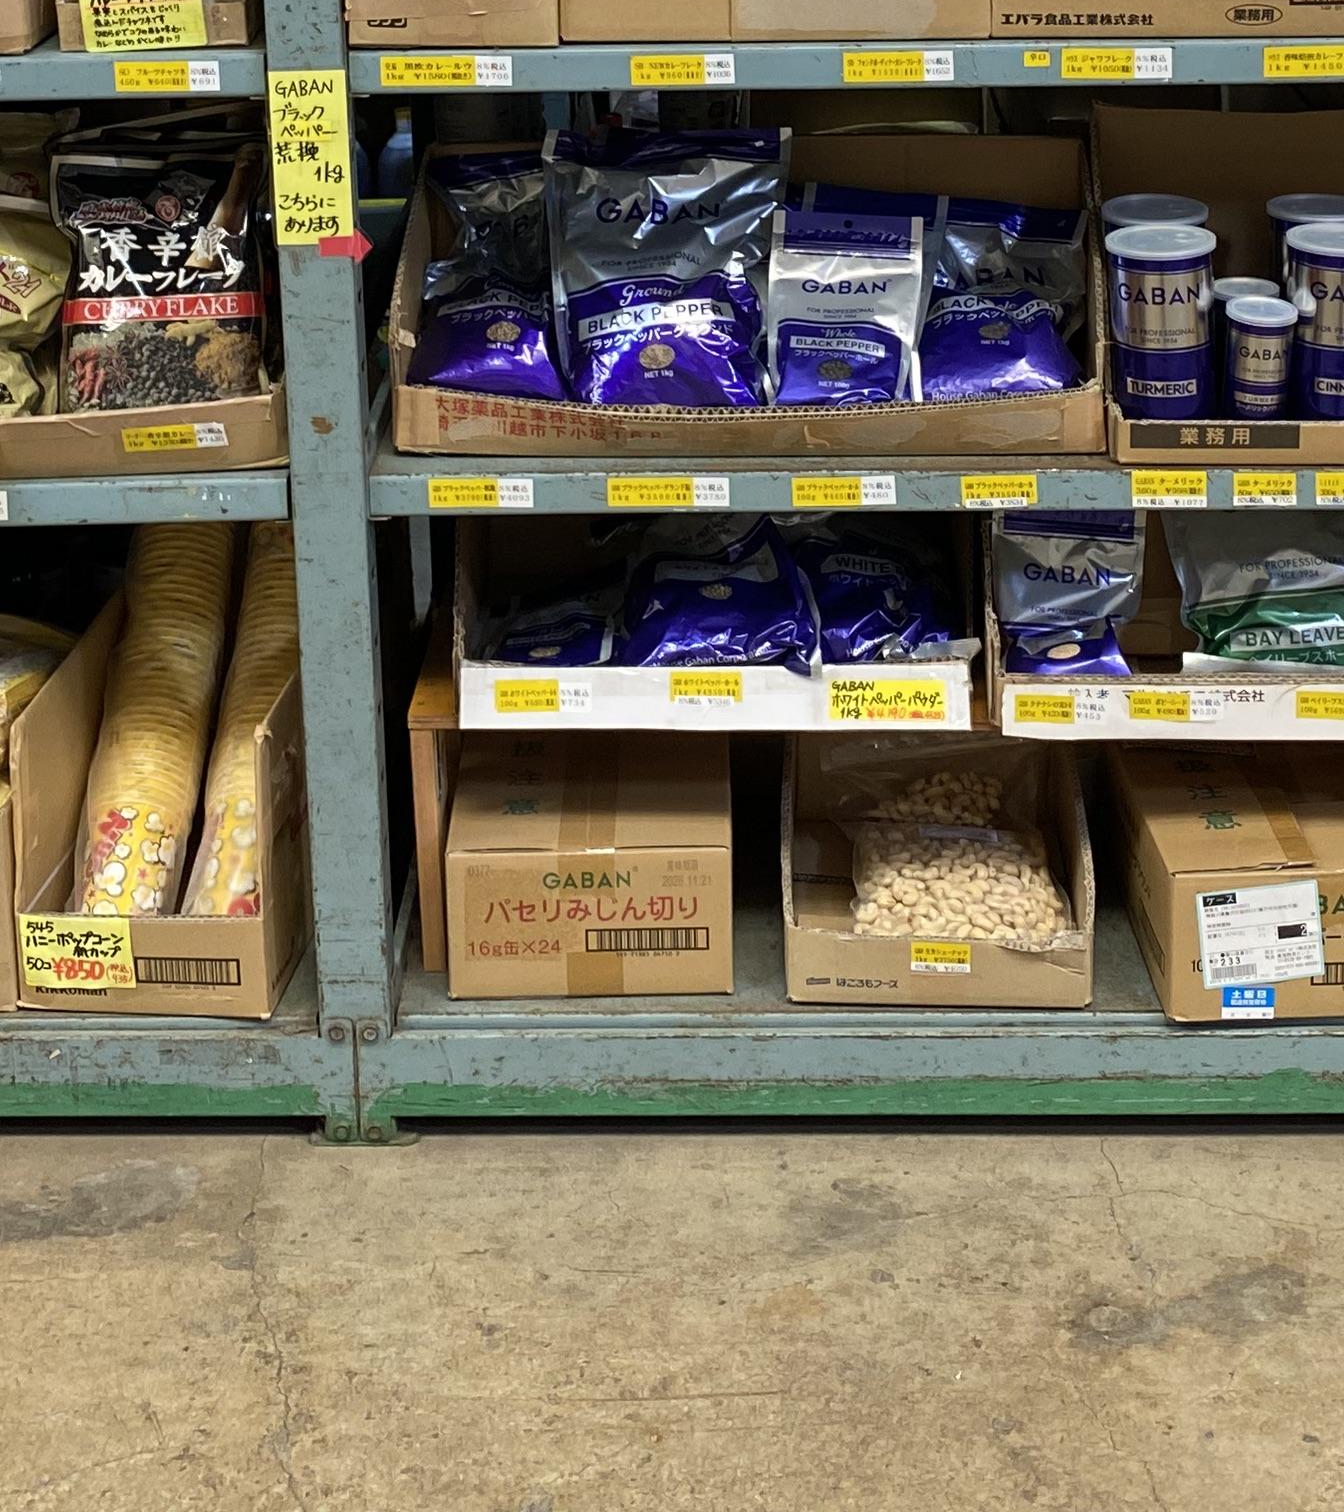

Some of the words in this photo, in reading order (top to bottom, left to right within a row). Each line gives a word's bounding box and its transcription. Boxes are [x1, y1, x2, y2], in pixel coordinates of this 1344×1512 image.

[1000, 10, 1154, 28] エバラ食品工業株式会社
[800, 279, 890, 297] GABAN
[1118, 281, 1202, 307] GABAN
[155, 294, 240, 317] FLAKE
[1129, 379, 1197, 396] TURMERIC
[1178, 426, 1252, 446] 業務用
[1022, 562, 1112, 586] GABAN
[1245, 628, 1280, 648] BAY
[542, 869, 632, 890] GABAN
[1204, 893, 1236, 906] ケース
[483, 895, 701, 925] パセリみじん切り
[466, 938, 562, 958] 16g缶×24
[52, 956, 106, 983] ¥850
